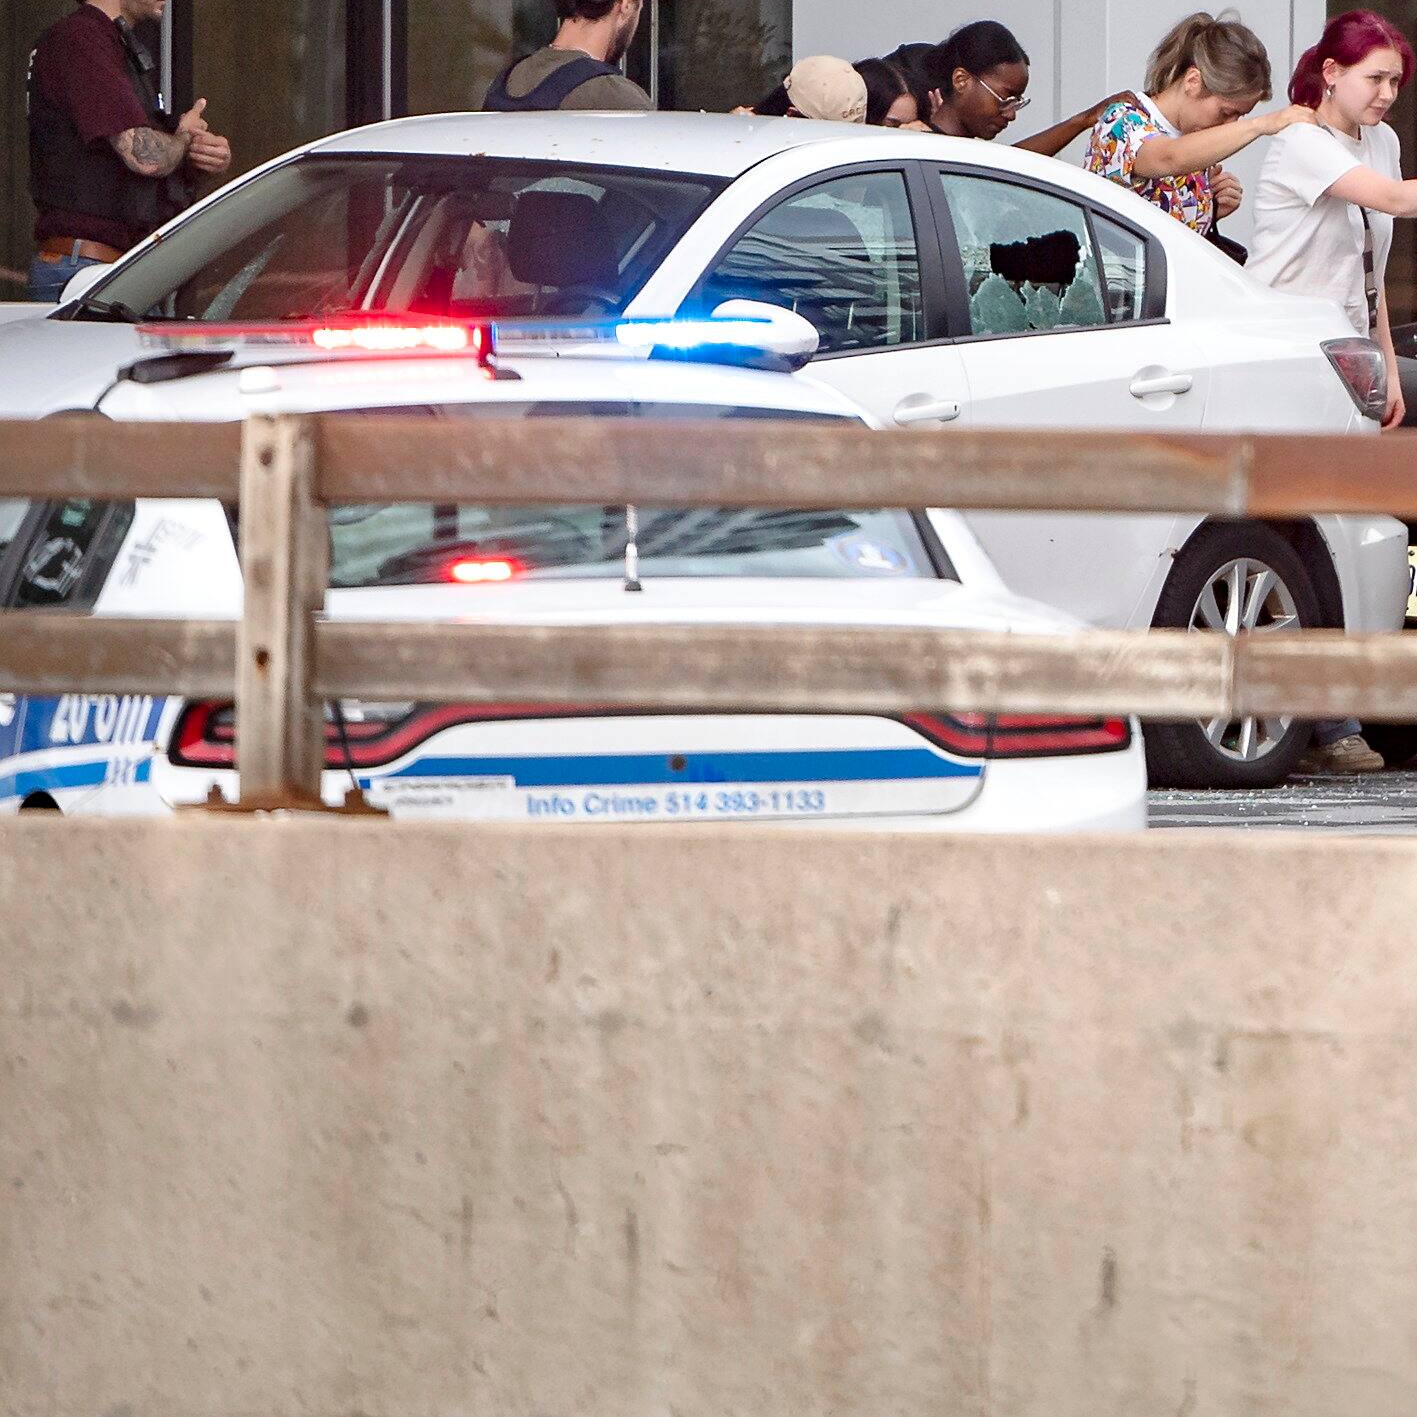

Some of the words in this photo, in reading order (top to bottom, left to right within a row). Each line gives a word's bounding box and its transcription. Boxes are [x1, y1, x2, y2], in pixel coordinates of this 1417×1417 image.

[526, 793, 575, 816] Info
[583, 792, 658, 814] Crime
[666, 791, 708, 813] 514
[716, 789, 825, 812] 393-1133
